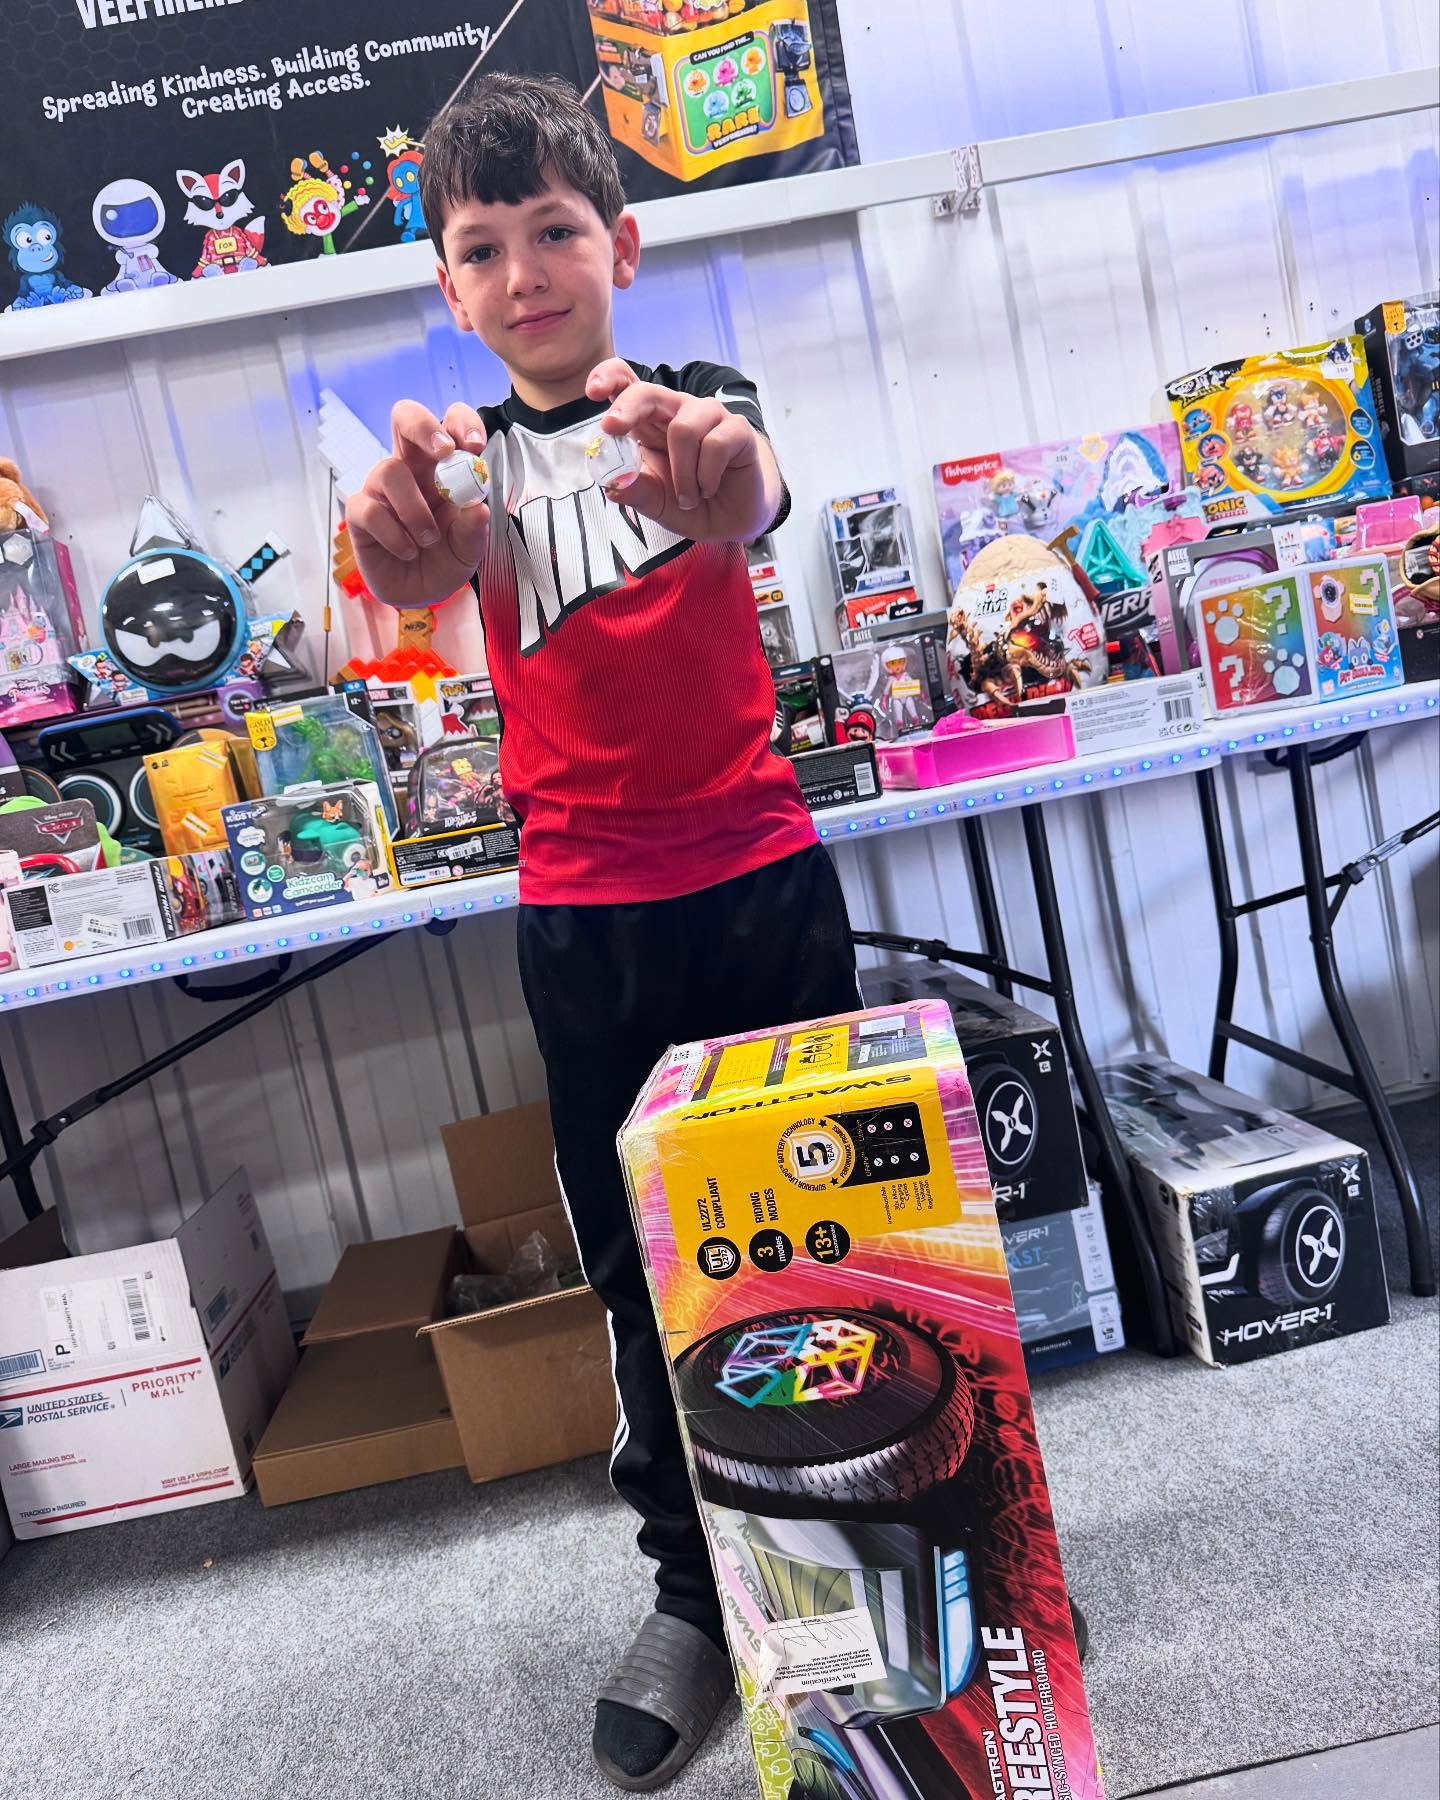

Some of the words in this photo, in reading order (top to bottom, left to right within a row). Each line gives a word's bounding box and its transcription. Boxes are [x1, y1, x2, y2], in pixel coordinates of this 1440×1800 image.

[43, 79, 157, 122] Spreading
[162, 65, 267, 98] Kindness.
[271, 44, 359, 77] Building
[182, 82, 282, 119] Creating
[287, 70, 371, 100] Access.
[218, 240, 234, 250] FOX
[284, 881, 342, 899] Camcorder
[288, 873, 335, 889] Kidzcam
[160, 894, 174, 932] TRUCKS
[682, 1074, 911, 1121] SWAGTRON
[796, 1142, 829, 1167] 5
[826, 1144, 835, 1162] YEAR
[707, 1177, 725, 1228] COMPLIANT
[750, 1191, 764, 1223] RIDING
[764, 1188, 779, 1221] MODES
[697, 1198, 711, 1231] UL2272
[757, 1246, 774, 1258] 3
[776, 1236, 786, 1262] modes
[815, 1226, 833, 1259] 13+
[709, 1249, 722, 1269] UL
[722, 1249, 730, 1265] 2272
[1216, 1303, 1333, 1347] HOVER-1
[27, 1397, 66, 1414] UNITED
[67, 1391, 103, 1407] STATES
[151, 1386, 184, 1399] MAIL
[27, 1411, 66, 1425] POSTAL
[67, 1402, 110, 1420] SERVICE
[9, 1462, 32, 1472] LARGE
[32, 1456, 61, 1469] MAILING
[61, 1453, 75, 1463] BOX
[161, 1477, 177, 1486] VISIT
[178, 1475, 186, 1483] US
[20, 1507, 51, 1518] TRACKED
[57, 1500, 86, 1511] INSURED
[801, 1674, 841, 1686] Verification
[843, 1672, 856, 1680] Box
[1032, 1649, 1058, 1730] HOVERBOARD
